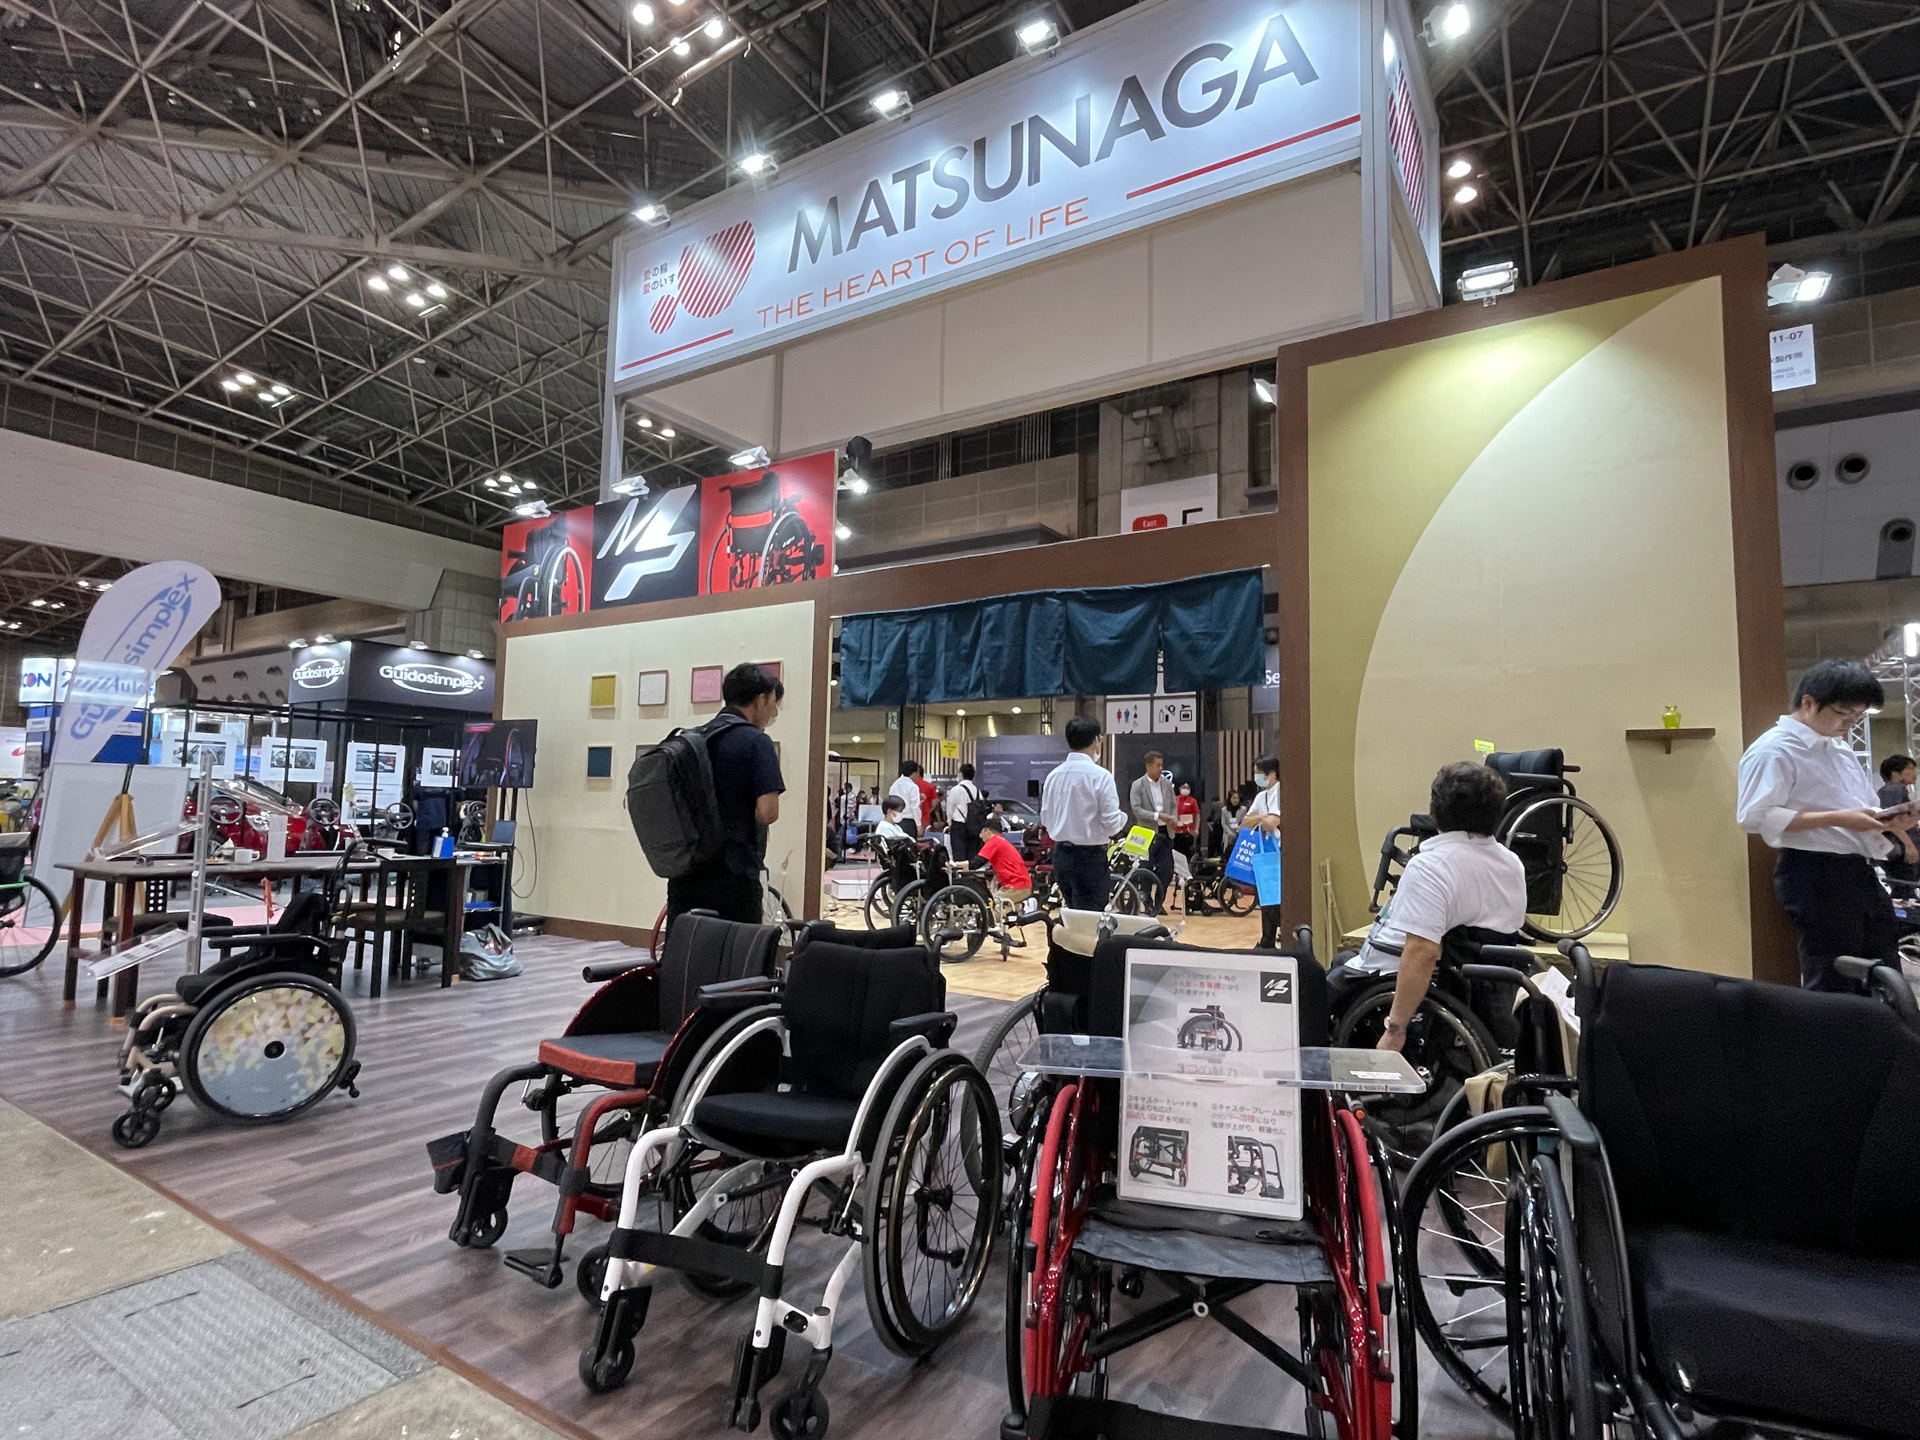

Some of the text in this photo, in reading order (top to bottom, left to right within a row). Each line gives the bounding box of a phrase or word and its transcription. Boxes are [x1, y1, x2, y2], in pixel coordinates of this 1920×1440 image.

[788, 15, 1320, 274] MATSUNAGA
[757, 196, 1090, 328] THE HEART OF LIFE
[1772, 331, 1804, 343] 11-07
[1142, 519, 1157, 528] East
[293, 663, 345, 681] Guidosimplex
[379, 664, 484, 690] Guidosimplex
[1238, 847, 1255, 856] you
[1240, 839, 1257, 850] Are
